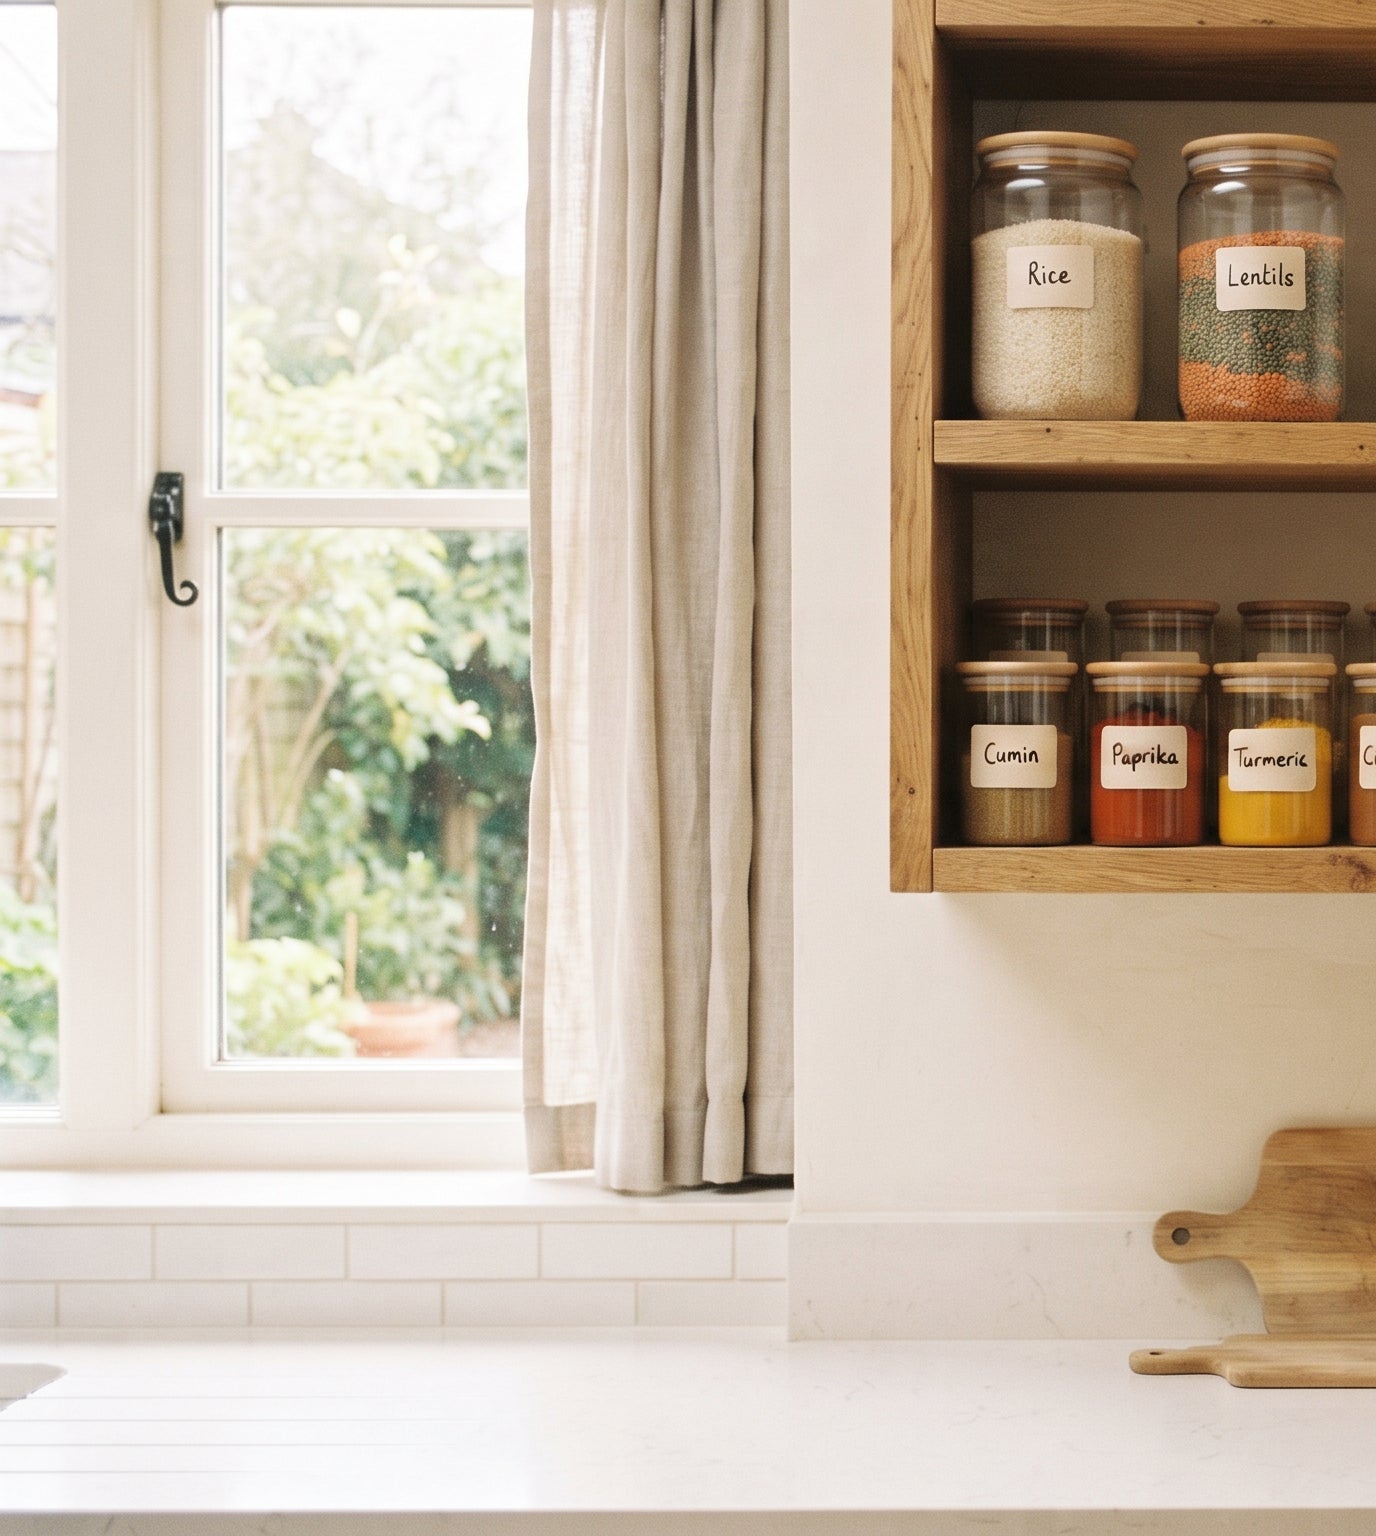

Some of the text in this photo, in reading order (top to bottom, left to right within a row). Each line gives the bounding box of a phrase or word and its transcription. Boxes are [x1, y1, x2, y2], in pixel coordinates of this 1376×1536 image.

[1028, 260, 1072, 286] Rice
[1228, 261, 1294, 288] Lentils
[984, 742, 1039, 765] Cumin
[1112, 742, 1179, 772] Paprika
[1233, 746, 1309, 768] Turmeric
